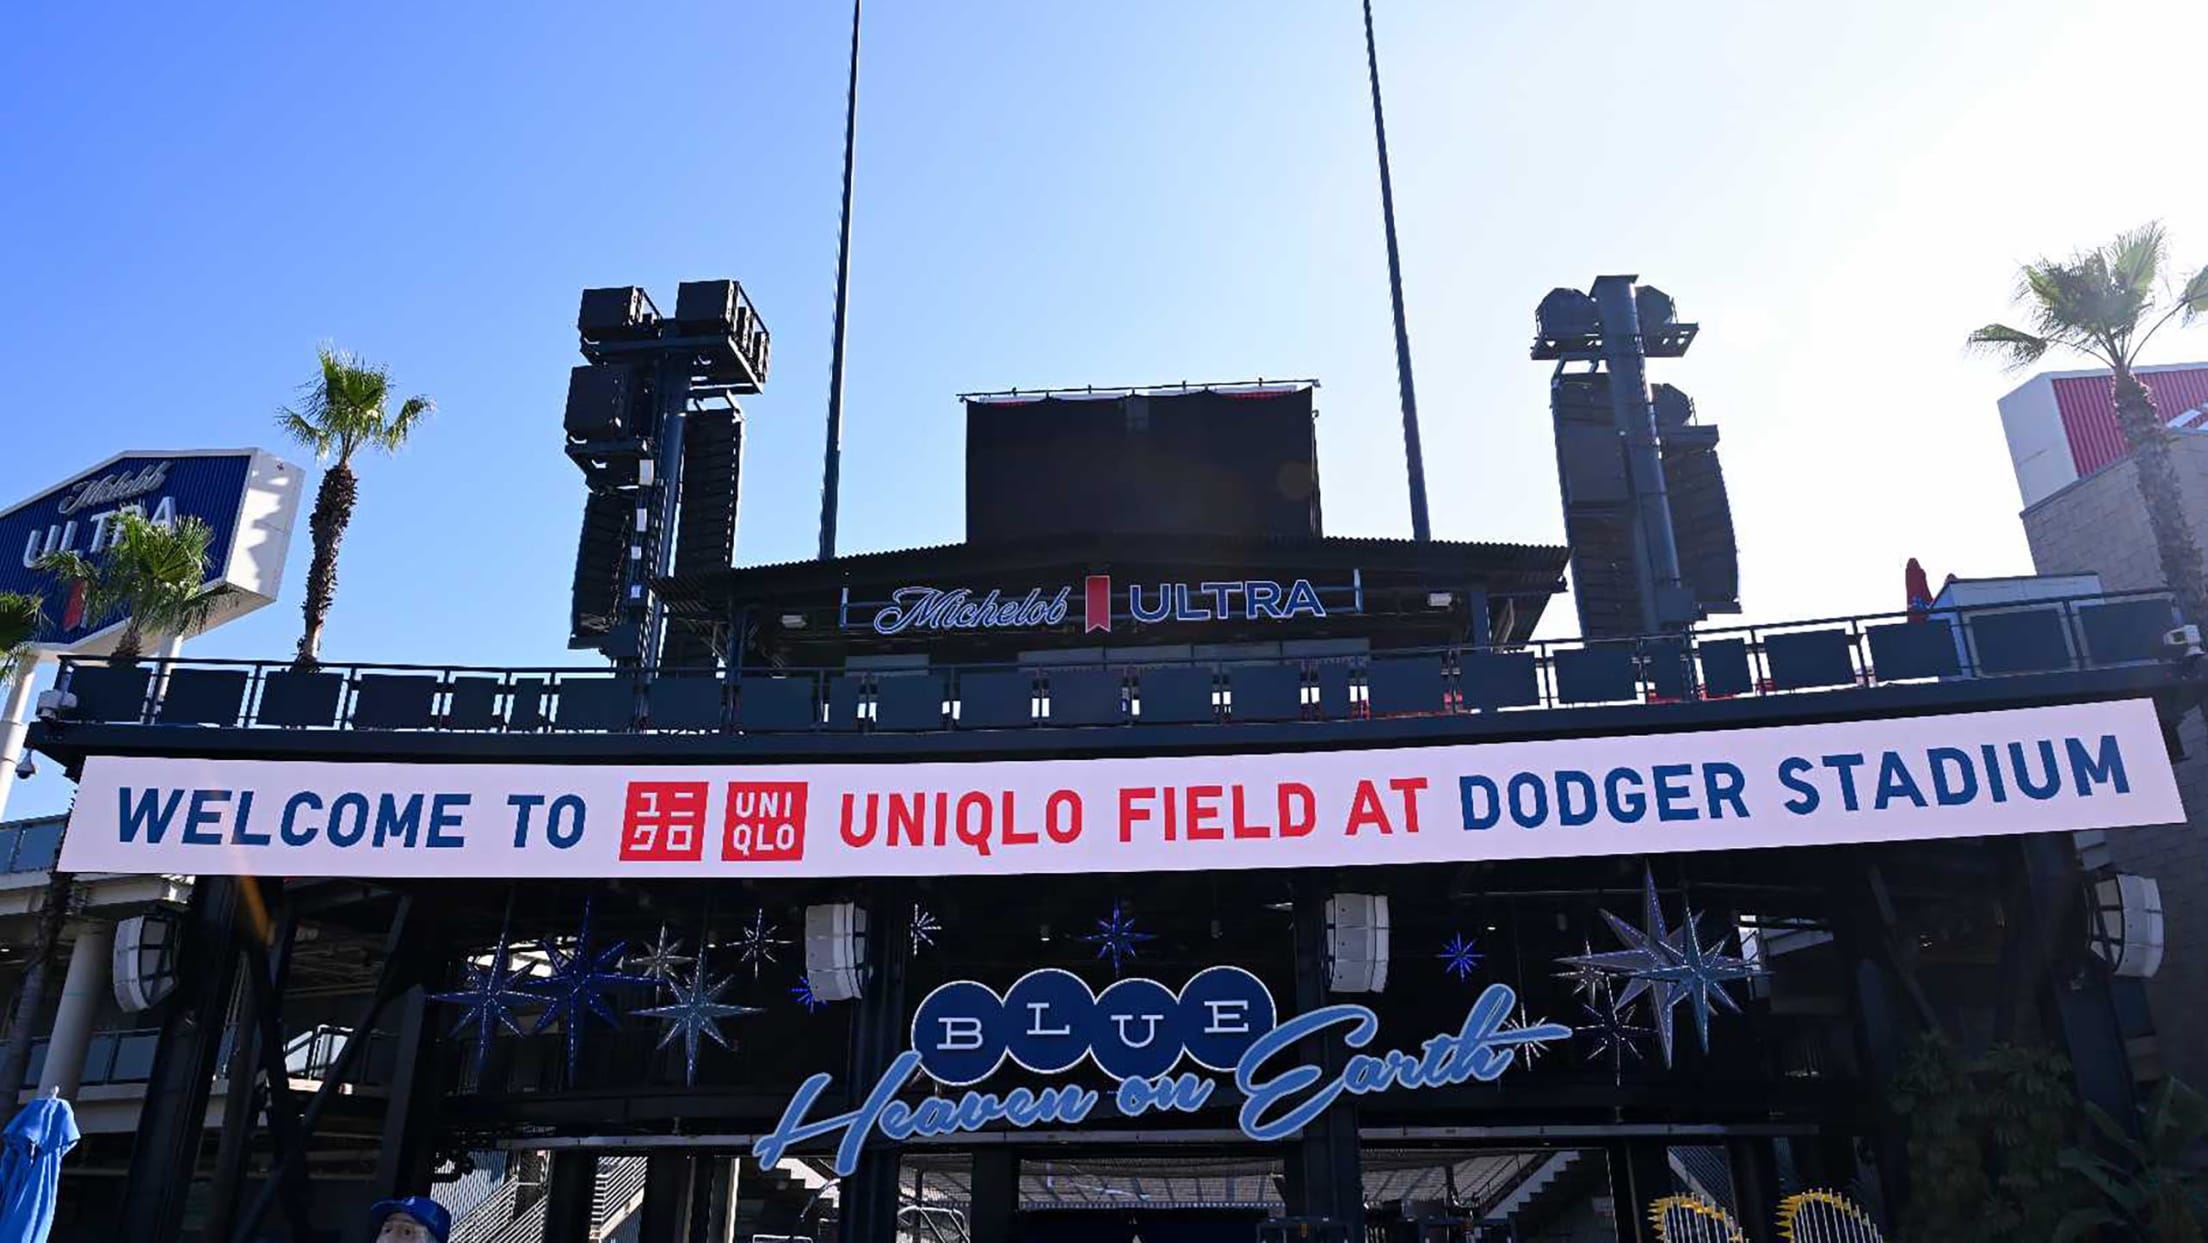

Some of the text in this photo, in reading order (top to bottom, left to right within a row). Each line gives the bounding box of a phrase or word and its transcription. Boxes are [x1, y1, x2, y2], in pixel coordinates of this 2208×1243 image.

[873, 579, 1327, 635] Michelob ULTRA
[118, 734, 2131, 857] WELCOME TO UNIQLO FIELD AT DODGER STADIUM
[735, 791, 792, 818] UNI
[733, 823, 795, 856] QLO
[936, 1000, 1249, 1051] BLUE
[752, 983, 1572, 1176] Heaven on Earth
